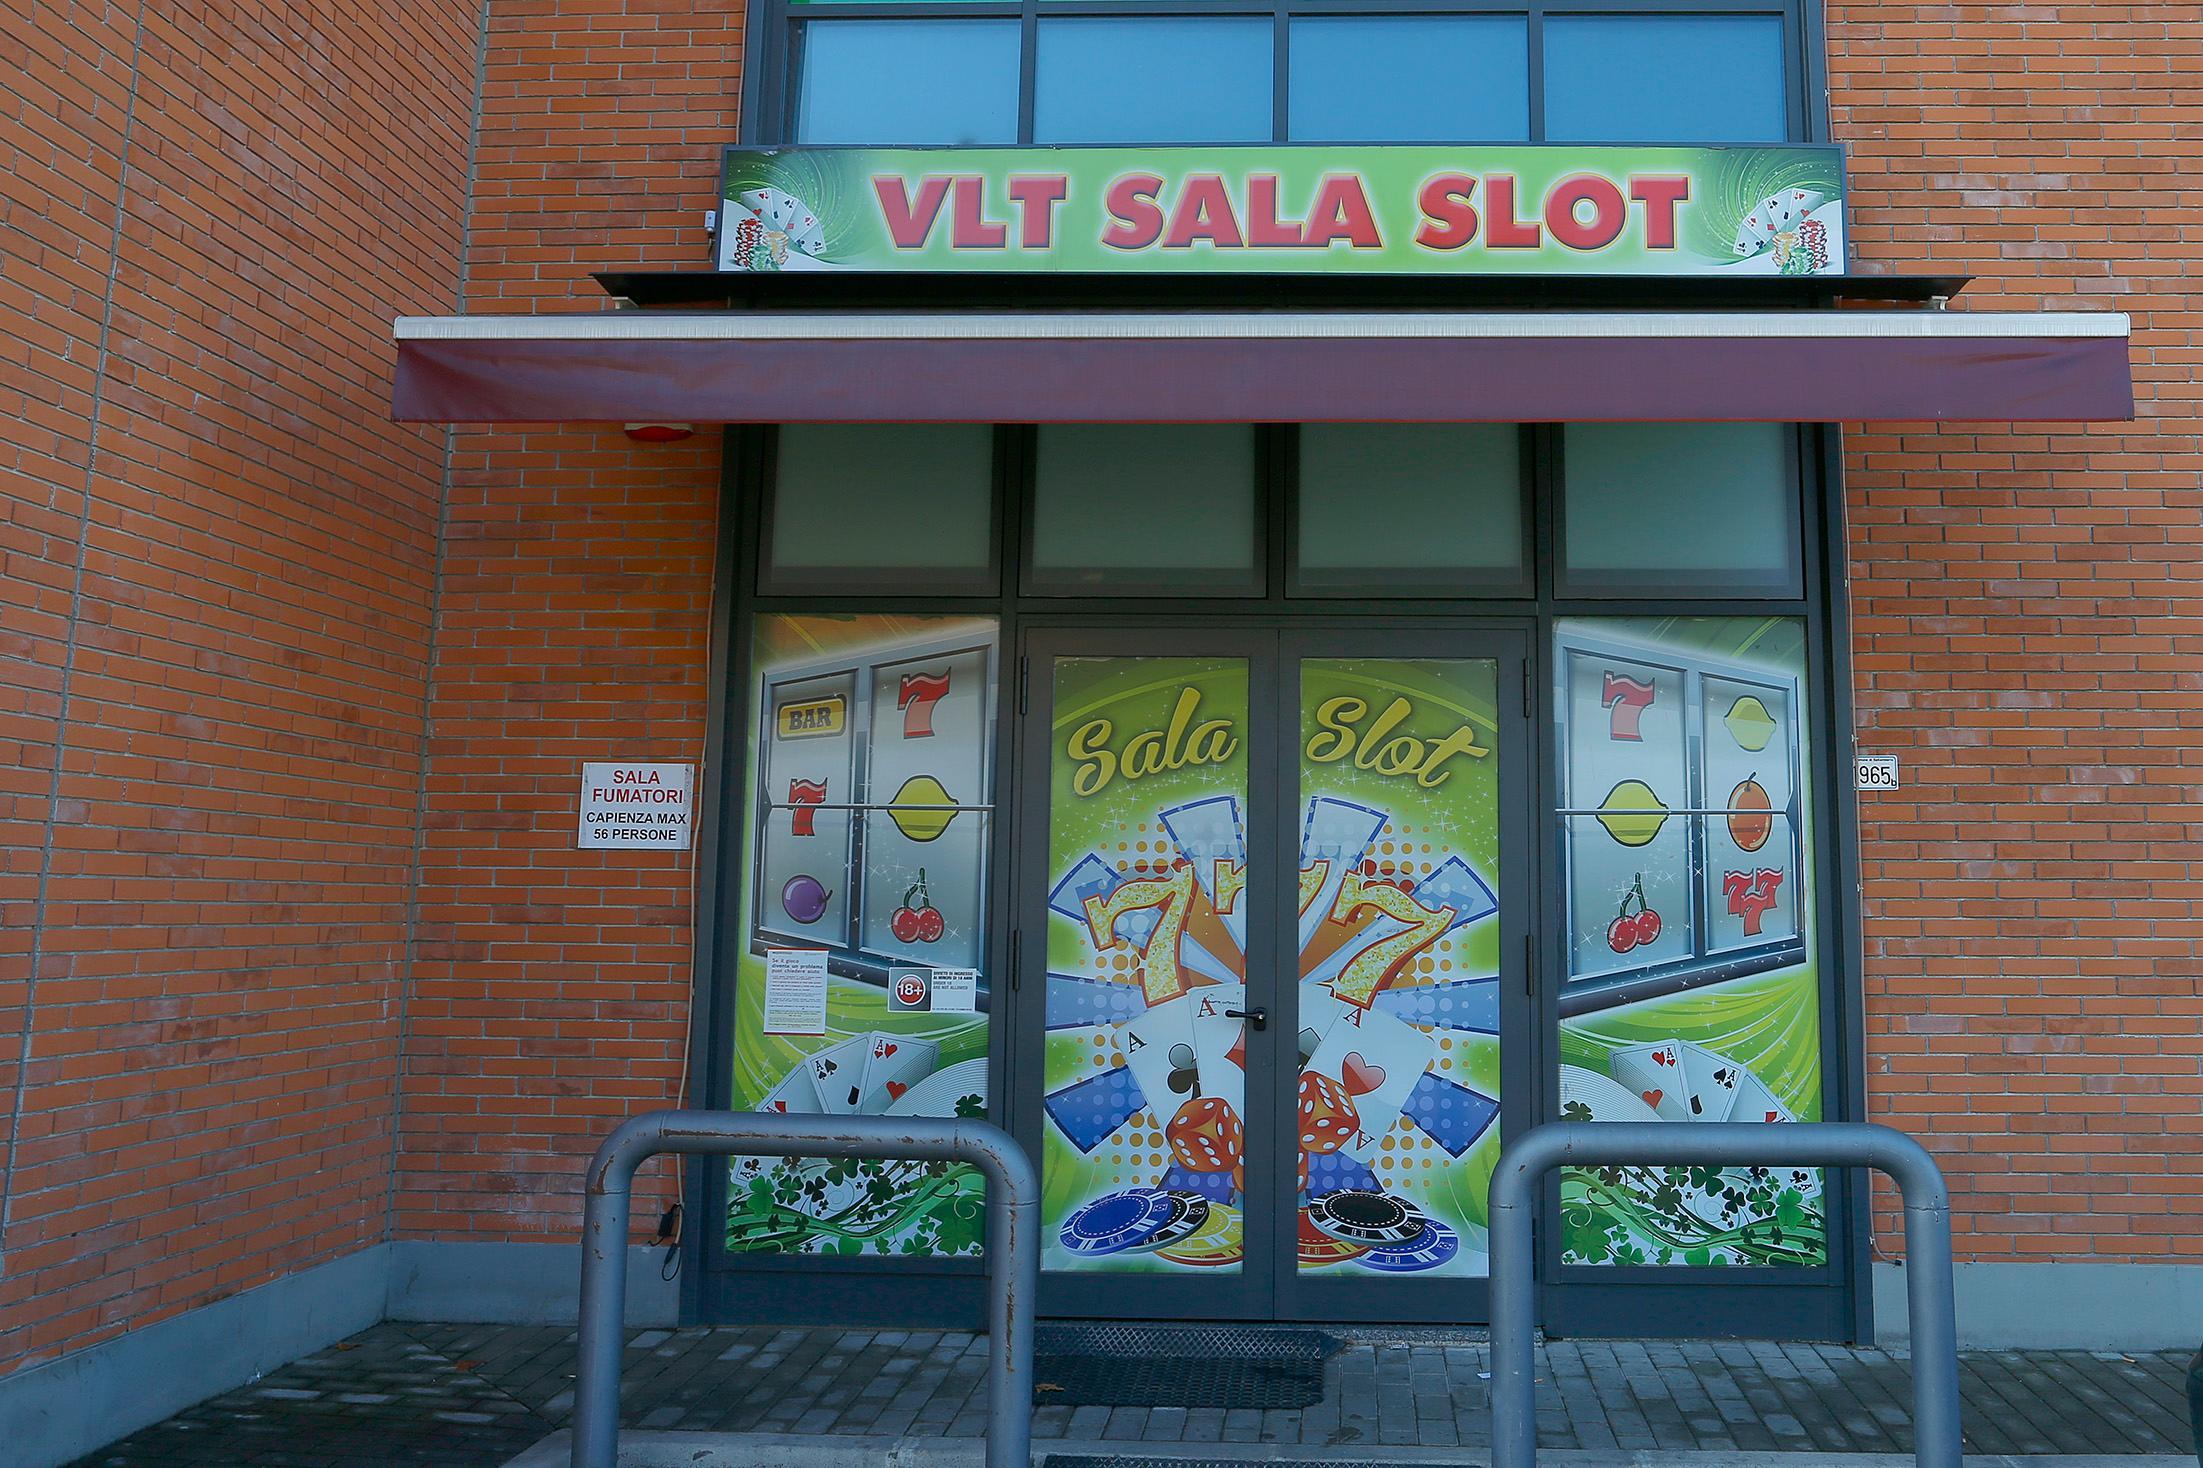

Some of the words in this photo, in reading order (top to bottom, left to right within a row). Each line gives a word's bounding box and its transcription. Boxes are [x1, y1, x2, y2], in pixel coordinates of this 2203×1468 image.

[872, 173, 1070, 251] VLT
[1099, 172, 1384, 252] SALA
[1414, 172, 1692, 252] SLOT
[788, 706, 833, 731] BAR
[1067, 686, 1239, 798] Sala
[1305, 696, 1490, 789] Slot
[613, 769, 661, 785] SALA
[592, 788, 683, 804] FUMATORI
[586, 811, 654, 824] CAPIENZA
[657, 813, 687, 825] MAX
[593, 828, 609, 839] 56
[612, 828, 677, 841] PERSONE
[896, 982, 923, 996] 18+
